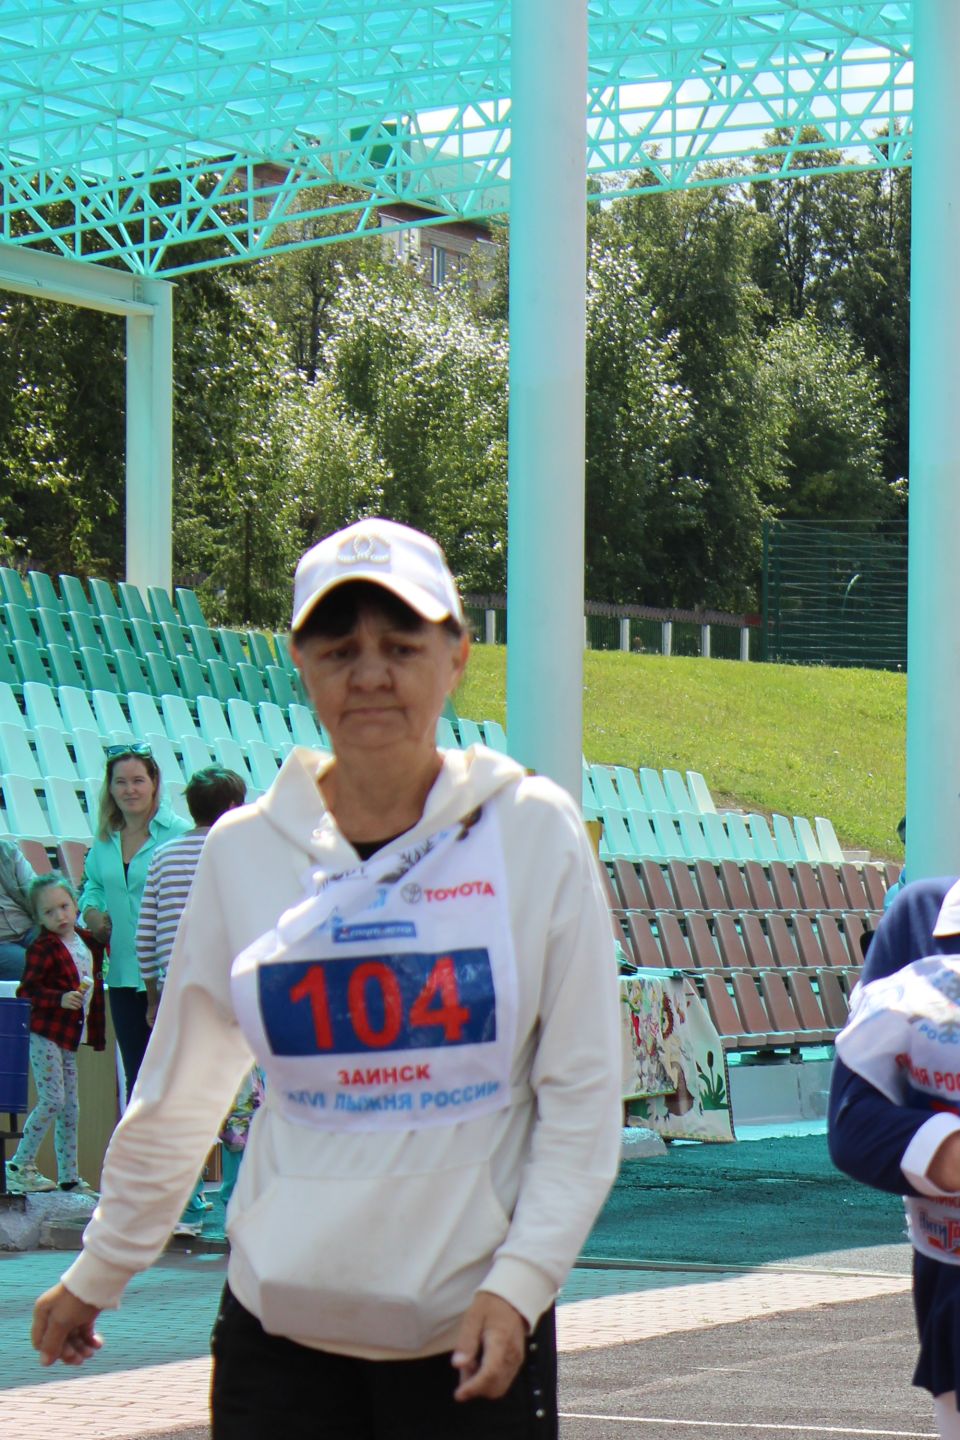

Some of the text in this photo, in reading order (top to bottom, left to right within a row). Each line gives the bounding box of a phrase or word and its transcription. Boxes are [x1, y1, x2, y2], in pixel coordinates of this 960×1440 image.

[424, 881, 495, 903] TOYOTA
[290, 956, 470, 1049] 104
[337, 1064, 431, 1086] ЗАИНСК
[334, 1092, 414, 1112] ЛЫЖНЯ
[421, 1079, 502, 1110] РОССИИ
